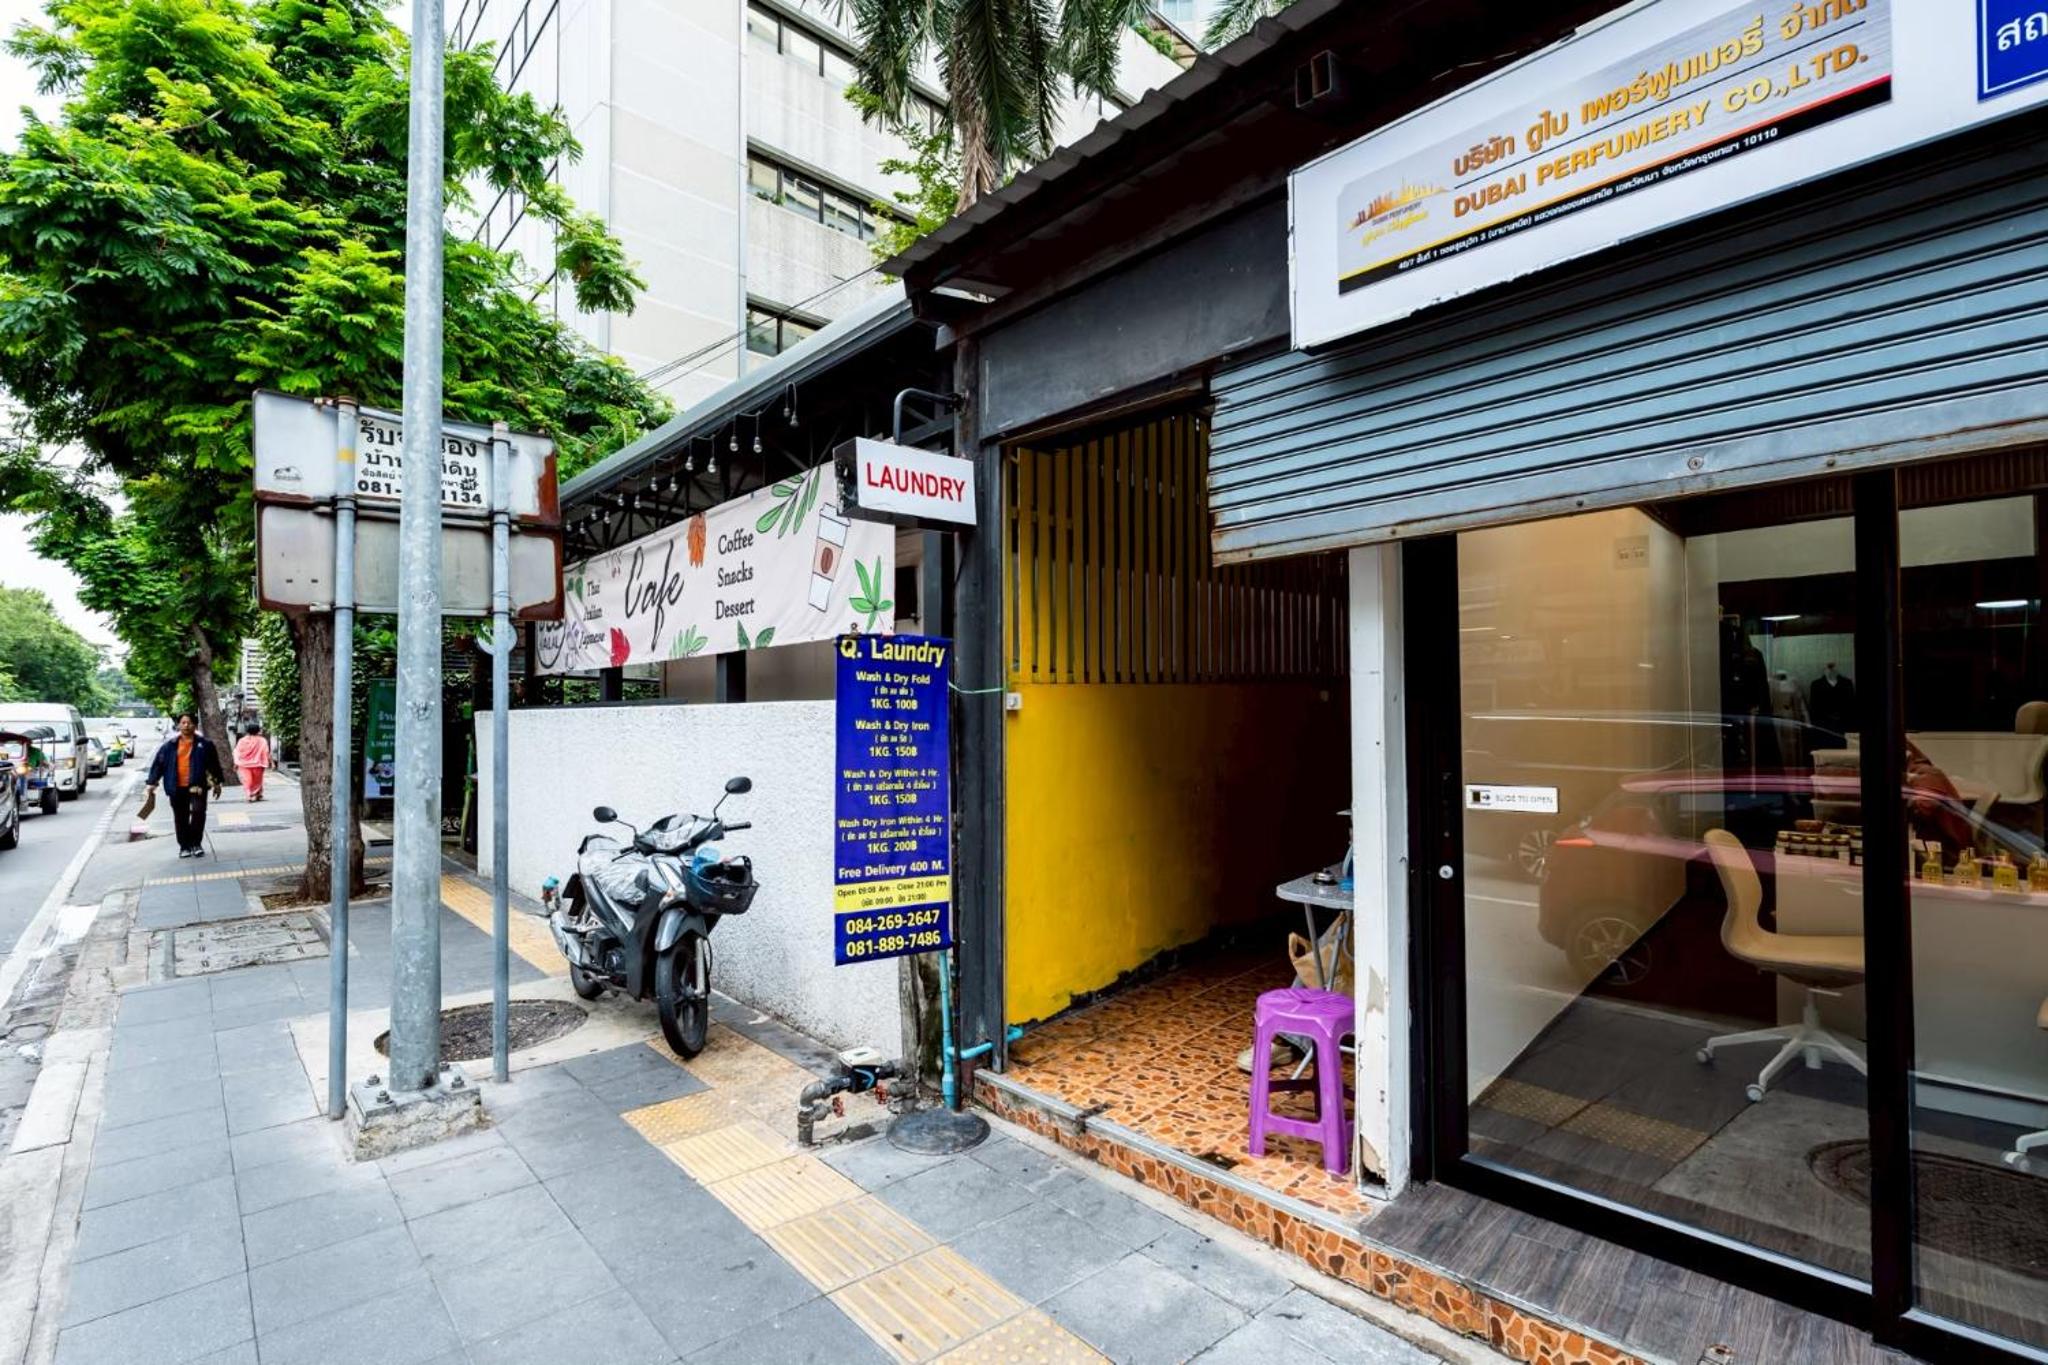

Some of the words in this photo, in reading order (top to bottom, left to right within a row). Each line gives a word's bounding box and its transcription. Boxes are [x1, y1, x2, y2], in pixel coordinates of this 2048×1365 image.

[1454, 136, 1516, 177] บริษัท
[1526, 110, 1569, 152] ดูไบ
[1454, 173, 1526, 217] DUBAI
[1537, 100, 1711, 186] PERFUMERY
[1480, 233, 1486, 241] 3
[1743, 128, 1778, 147] 10110
[866, 462, 965, 503] LAUNDRY
[718, 528, 754, 555] Coffee
[717, 560, 753, 587] Snacks
[625, 539, 684, 652] Cafe
[715, 597, 754, 620] Dessert
[841, 639, 862, 659] Q.
[871, 638, 945, 668] Laundry
[856, 671, 881, 682] Wash
[885, 673, 891, 682] &
[894, 674, 908, 685] Dry
[912, 674, 930, 684] Fold
[871, 699, 892, 709] 1KG.
[895, 700, 918, 710] 100B
[855, 720, 881, 730] Wash
[884, 720, 891, 730] &
[893, 721, 908, 732] Dry
[912, 722, 930, 730] Iron
[869, 747, 892, 757] 1KG.
[895, 746, 918, 757] 150B
[843, 770, 866, 778] Wash
[869, 769, 876, 778] &
[878, 769, 892, 780] Dry
[894, 768, 918, 777] Within
[920, 769, 926, 777] 4
[928, 768, 940, 777] Hr.
[869, 795, 891, 805] 1KG.
[895, 794, 917, 804] 150B
[838, 819, 860, 828] Wash
[862, 818, 877, 829] Dry
[880, 818, 896, 826] Iron
[898, 816, 923, 825] Within
[867, 843, 891, 853] 1KG.
[894, 840, 918, 851] 200B
[839, 868, 861, 879] Free
[865, 864, 906, 876] Delivery
[910, 861, 928, 872] 400
[931, 860, 945, 870] M.
[837, 889, 857, 898] Open
[897, 882, 915, 890] Close
[846, 910, 940, 935] 084-269-2647
[846, 931, 941, 957] 081-889-7486
